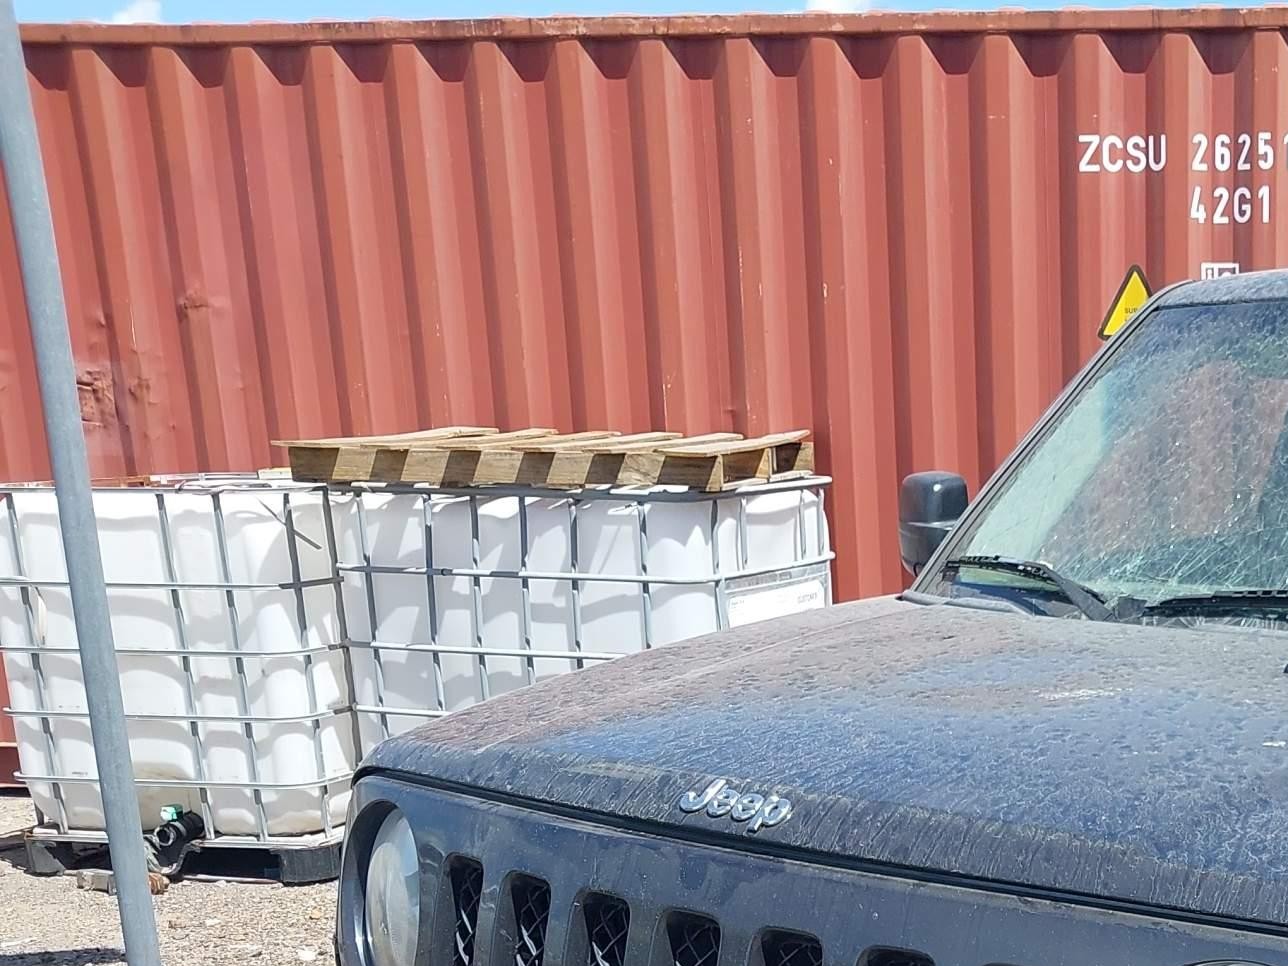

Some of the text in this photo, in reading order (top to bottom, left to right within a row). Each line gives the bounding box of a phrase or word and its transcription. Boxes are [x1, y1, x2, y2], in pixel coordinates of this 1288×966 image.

[1078, 134, 1167, 173] ZCSU
[1190, 185, 1270, 224] 42G1
[679, 778, 794, 834] Jeep
